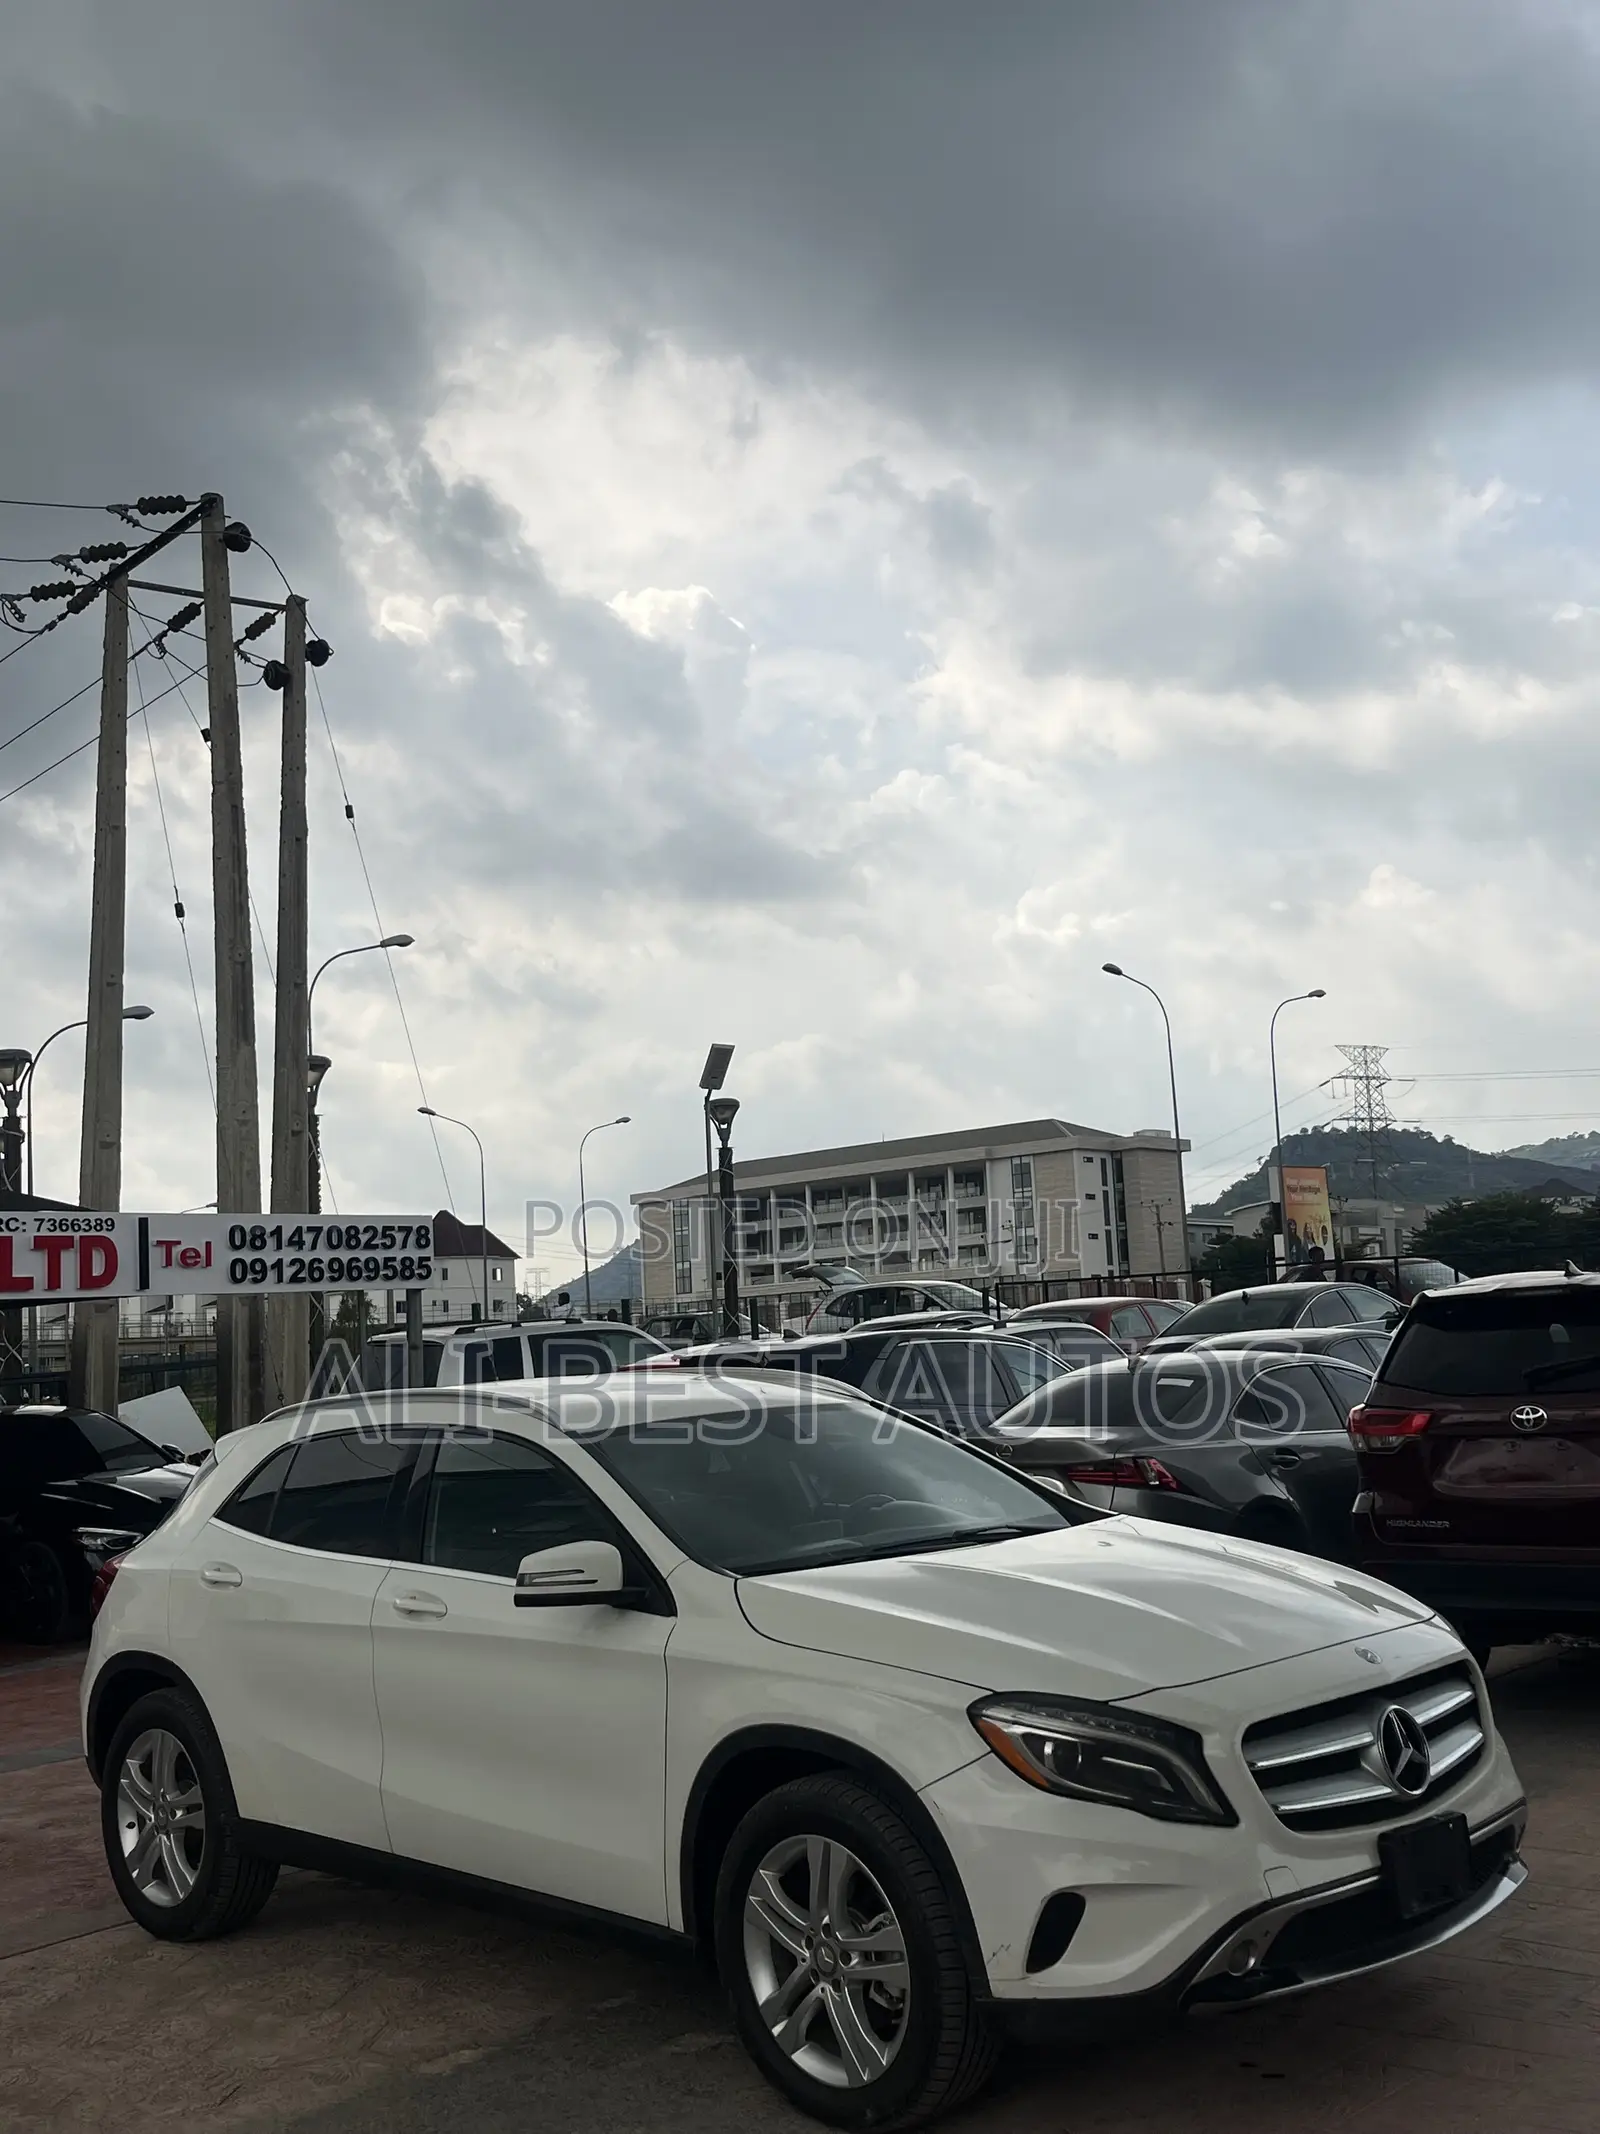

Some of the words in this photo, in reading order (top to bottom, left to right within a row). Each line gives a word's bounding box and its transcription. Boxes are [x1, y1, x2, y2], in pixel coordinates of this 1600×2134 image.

[33, 1217, 116, 1233] 7366389
[228, 1224, 431, 1251] 08147082578
[0, 1235, 119, 1293] LTD
[154, 1240, 213, 1268] Tel
[229, 1256, 433, 1284] 09126969585
